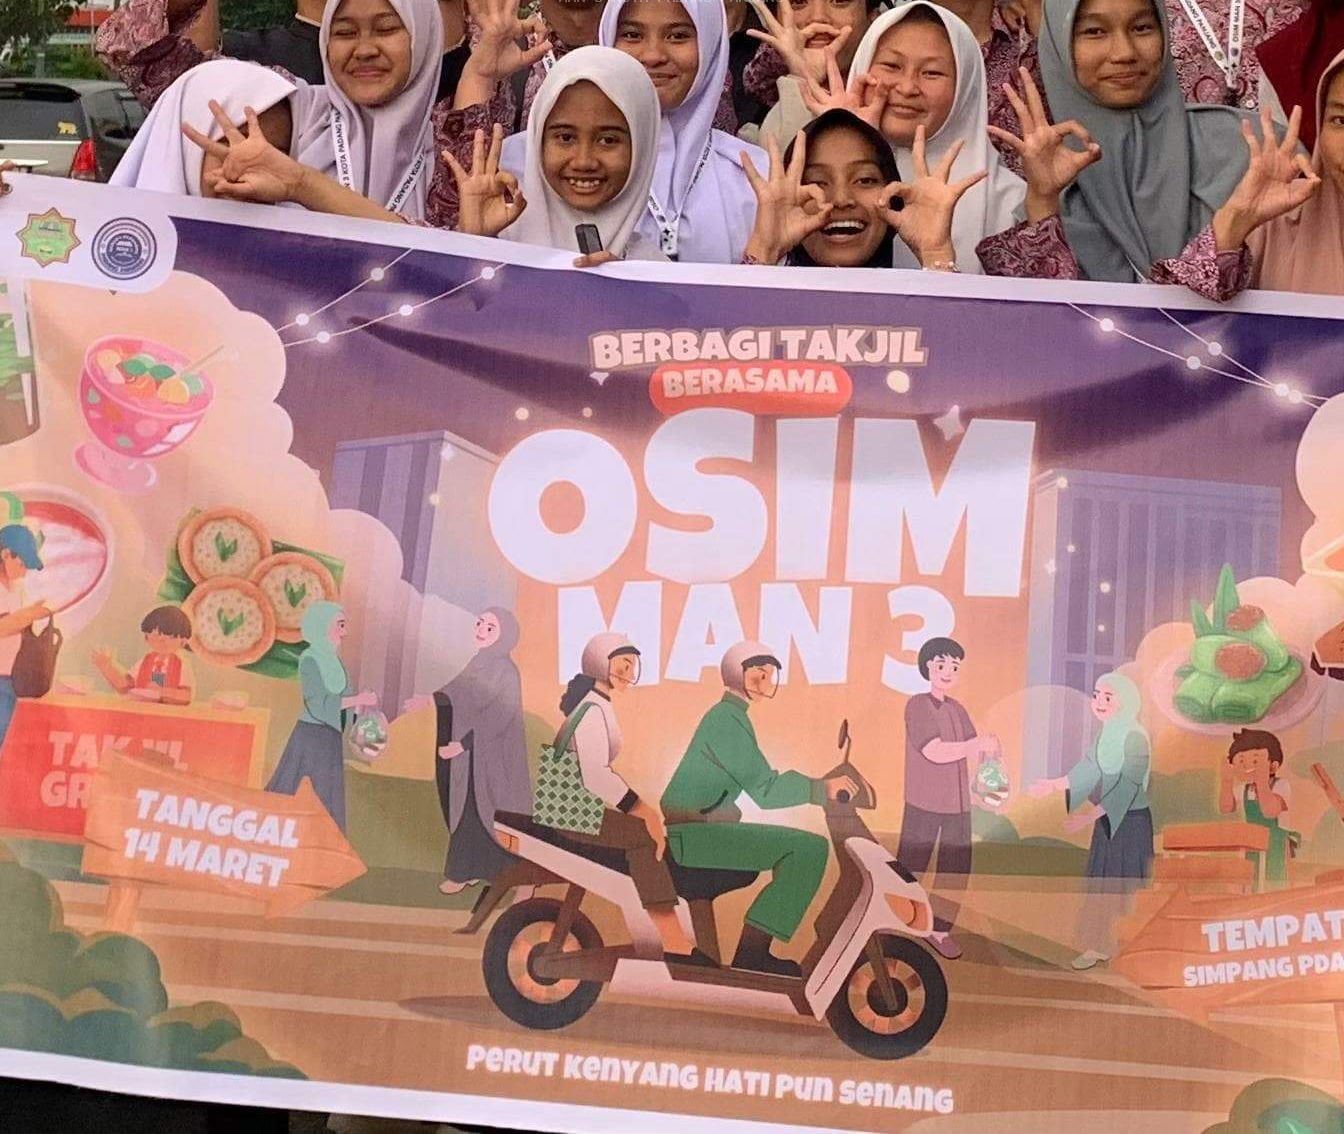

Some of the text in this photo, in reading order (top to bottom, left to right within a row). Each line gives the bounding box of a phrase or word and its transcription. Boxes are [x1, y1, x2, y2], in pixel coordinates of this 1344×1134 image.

[334, 124, 345, 152] PADANG
[339, 154, 348, 174] KOTA
[592, 328, 925, 367] BERBAGI TAKJIL
[662, 368, 839, 398] BERASAMA
[487, 406, 1036, 598] OSIM
[555, 580, 956, 696] MAN 3
[136, 788, 300, 849] TANGGAL
[123, 826, 290, 888] 14 MARET
[1182, 956, 1293, 988] SIMPANG
[704, 1067, 770, 1097] HATI
